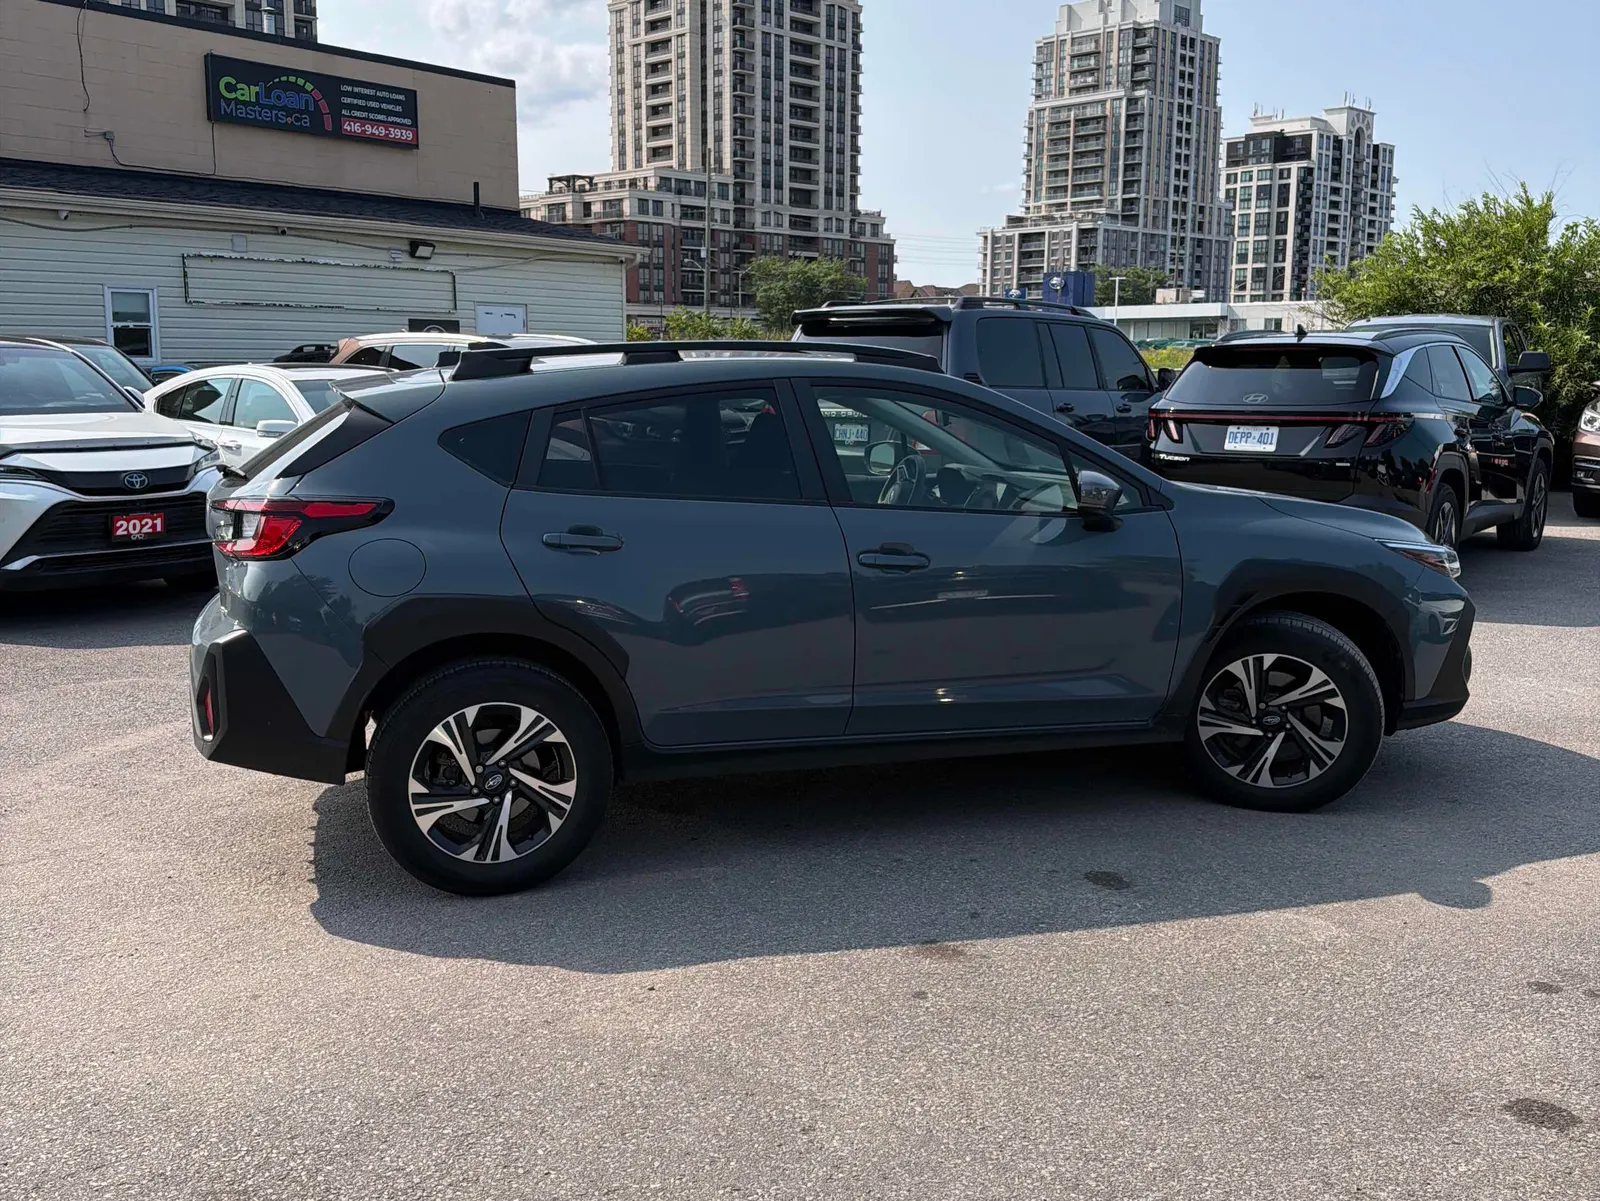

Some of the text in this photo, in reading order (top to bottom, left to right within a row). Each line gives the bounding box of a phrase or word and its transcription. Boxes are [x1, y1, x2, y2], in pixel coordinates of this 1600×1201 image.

[353, 87, 376, 96] INTEREST
[341, 97, 366, 106] CERTIFIED
[380, 103, 402, 112] VEHICLES
[351, 110, 368, 118] CREDIT
[369, 113, 387, 122] SCORES
[387, 116, 412, 125] APPROVED
[343, 121, 413, 140] 416-949-3939
[1228, 431, 1274, 445] DEPP 401
[116, 517, 162, 535] 2021
